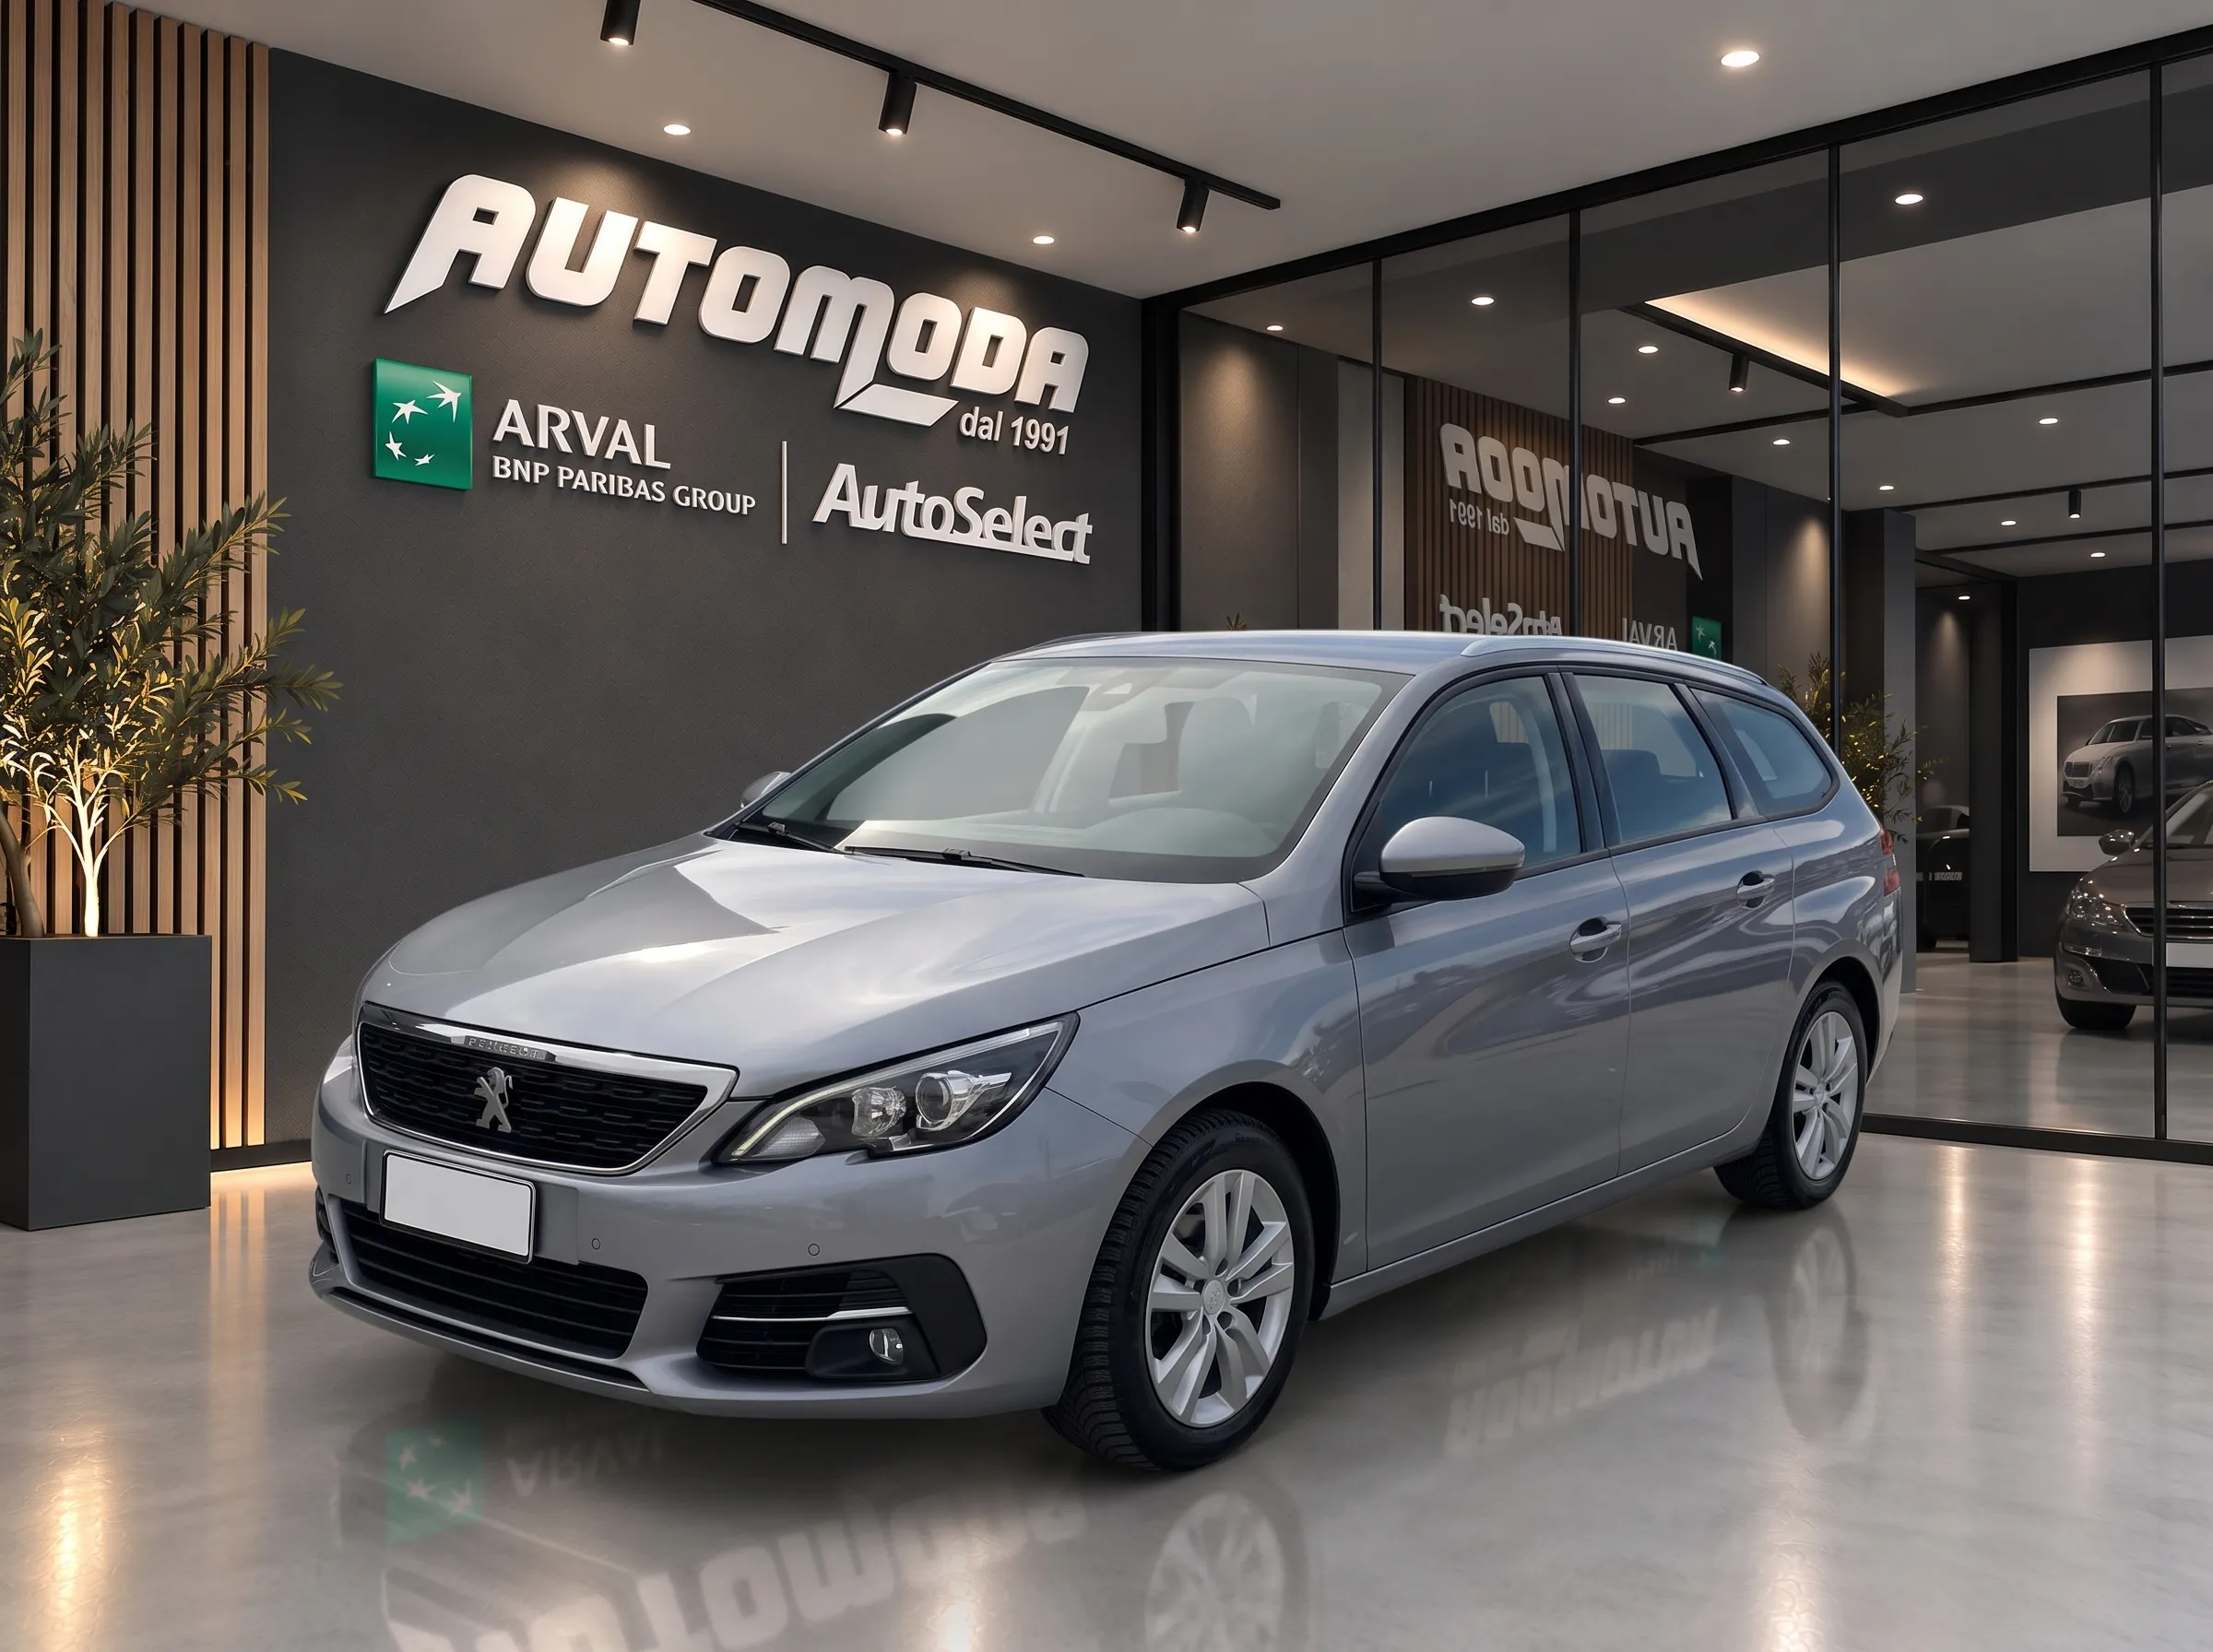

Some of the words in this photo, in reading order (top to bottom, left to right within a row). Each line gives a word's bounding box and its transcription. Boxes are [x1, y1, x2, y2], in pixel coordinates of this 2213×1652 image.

[384, 173, 1089, 427] AUTOMODA
[492, 398, 671, 470] ARVAL
[959, 406, 1003, 442] dal
[1011, 416, 1070, 455] 1991
[492, 455, 550, 484] BNP
[557, 466, 666, 503] PARIBAS
[672, 485, 756, 515] GROUP
[812, 463, 1094, 565] AutoSelect
